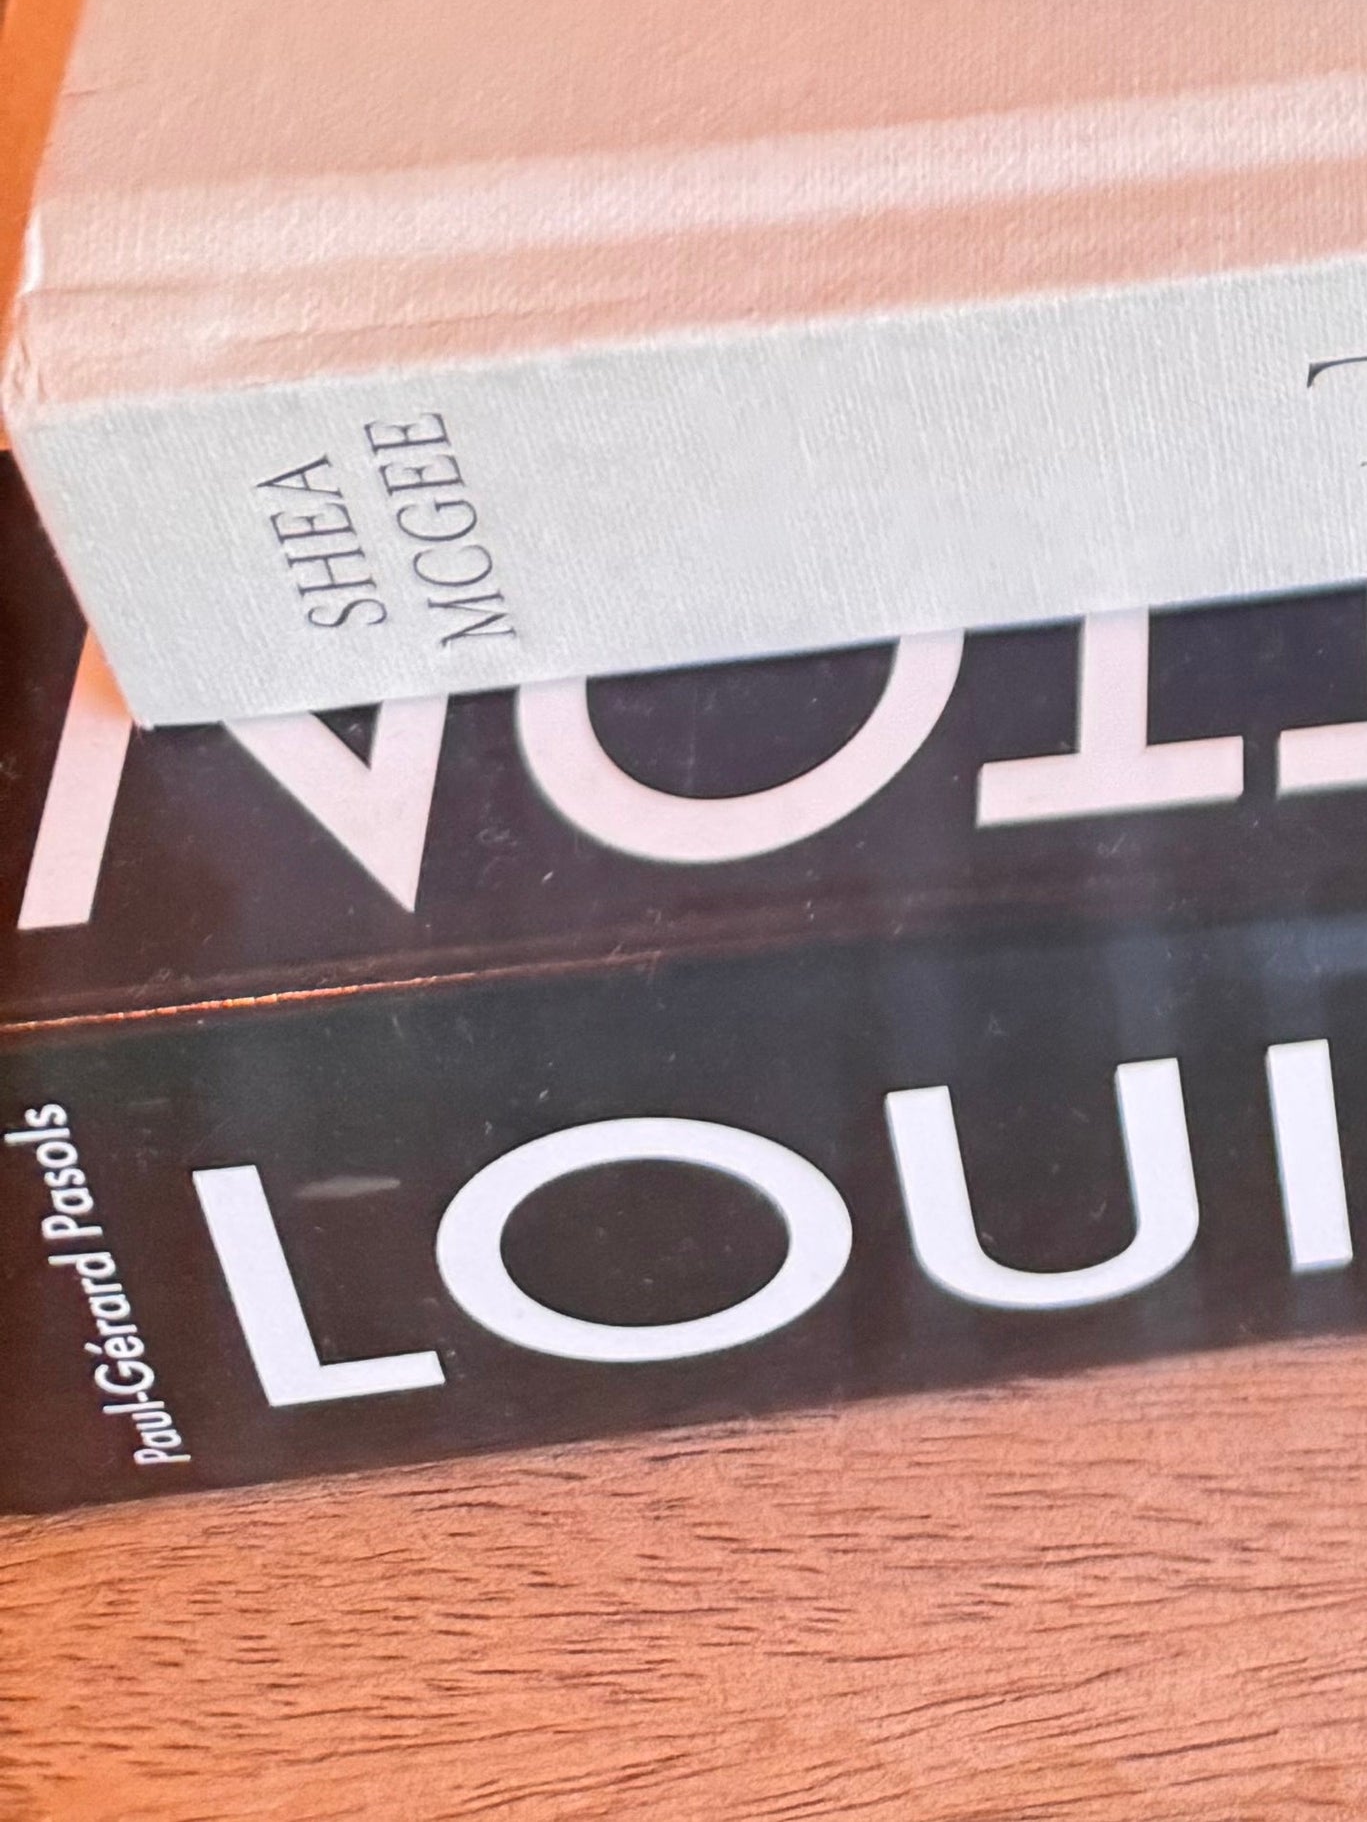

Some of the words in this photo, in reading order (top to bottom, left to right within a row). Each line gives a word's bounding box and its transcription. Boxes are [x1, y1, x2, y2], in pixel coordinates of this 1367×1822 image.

[255, 454, 389, 629] SHEA
[363, 412, 518, 649] MCGEE
[4, 1103, 104, 1241] Pasols
[47, 1251, 192, 1465] Paul-Gérard
